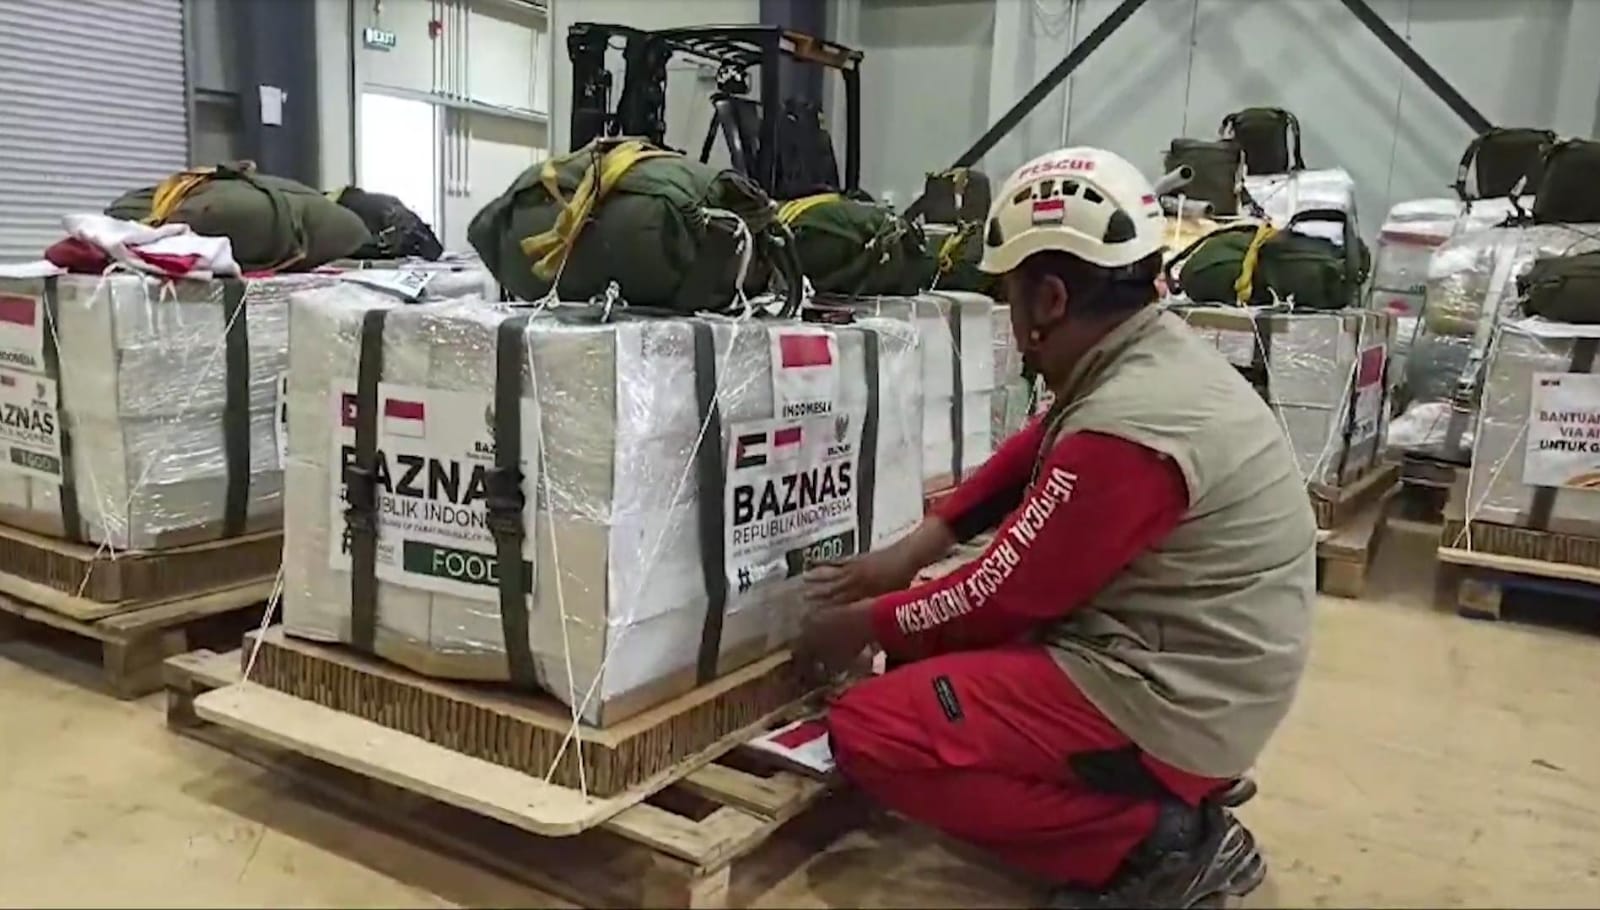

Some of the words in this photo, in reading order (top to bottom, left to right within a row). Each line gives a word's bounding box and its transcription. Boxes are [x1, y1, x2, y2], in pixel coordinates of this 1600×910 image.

[0, 402, 54, 435] ZNAS
[783, 401, 832, 418] INDONESIA
[1560, 426, 1583, 438] VIA
[1540, 440, 1587, 452] UNTUK
[733, 460, 852, 526] BAZNAS
[733, 515, 797, 546] REPUBLIK
[797, 498, 852, 530] INDONESIA
